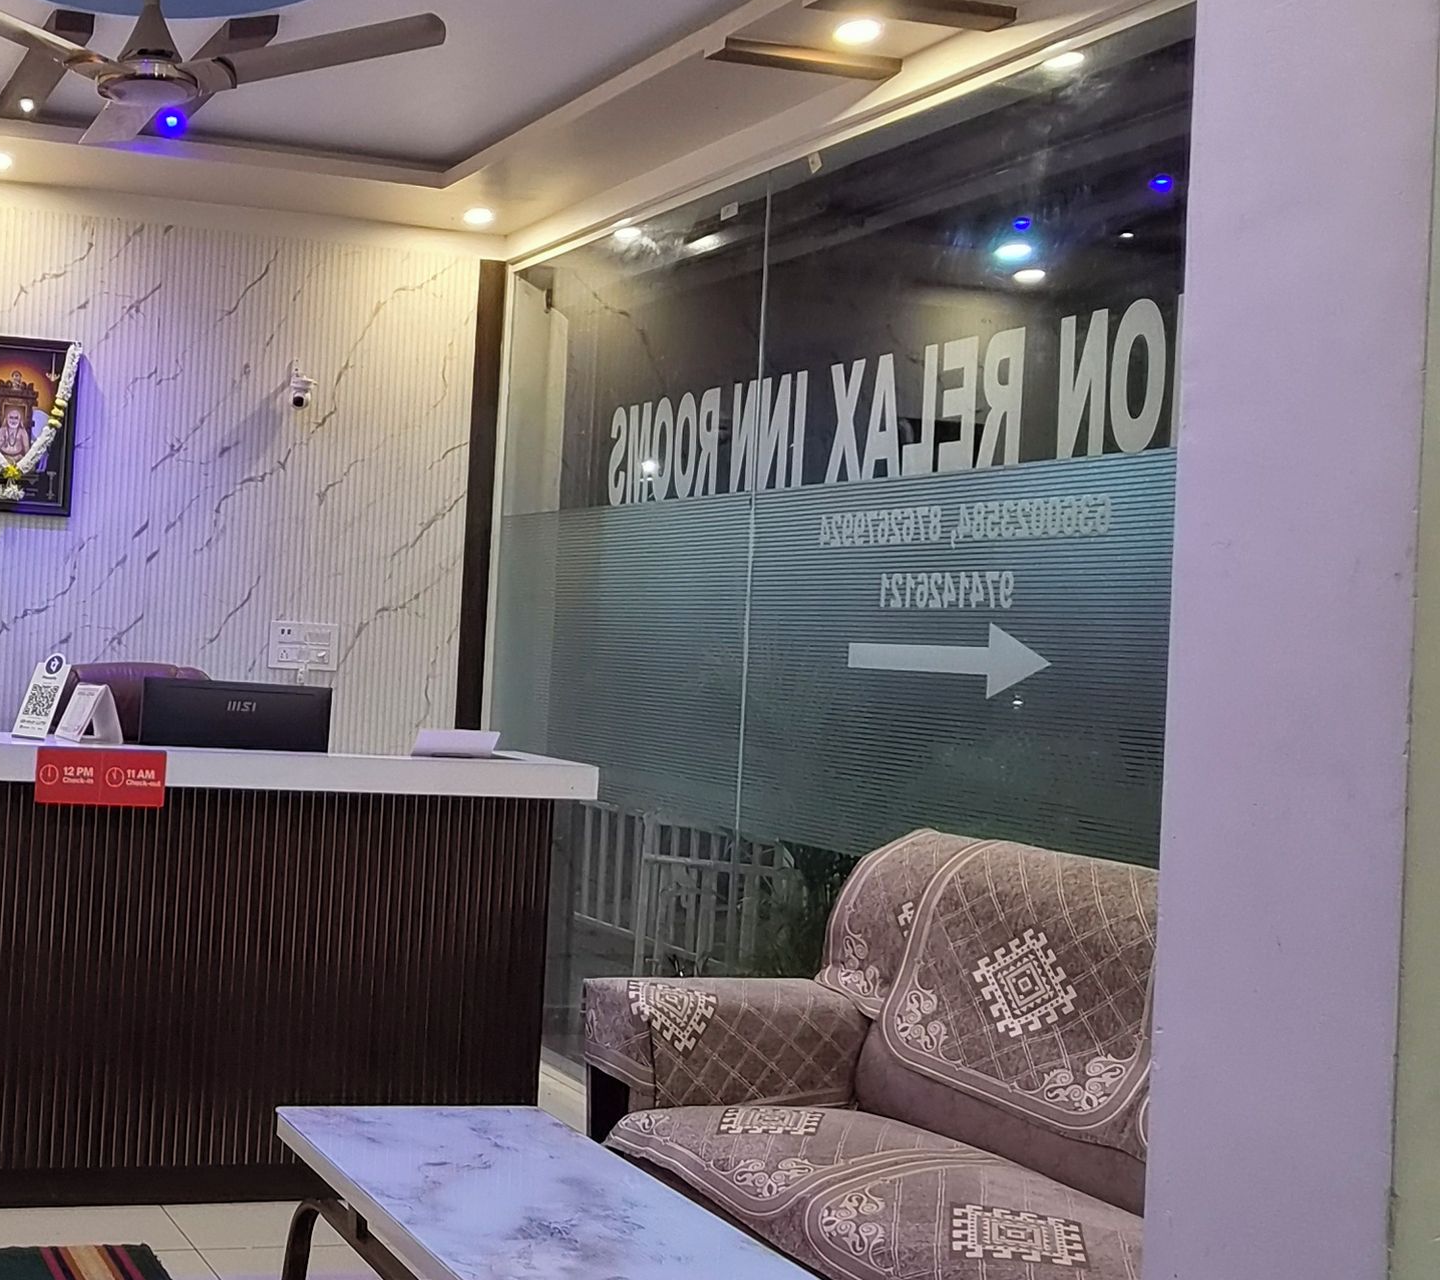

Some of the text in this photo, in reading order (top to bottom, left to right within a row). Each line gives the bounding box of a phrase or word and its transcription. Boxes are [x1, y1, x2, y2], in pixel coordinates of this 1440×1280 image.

[63, 766, 94, 777] 12 PM
[126, 769, 155, 780] 11 AM
[62, 776, 94, 784] Check-in
[125, 779, 161, 787] Check-out
